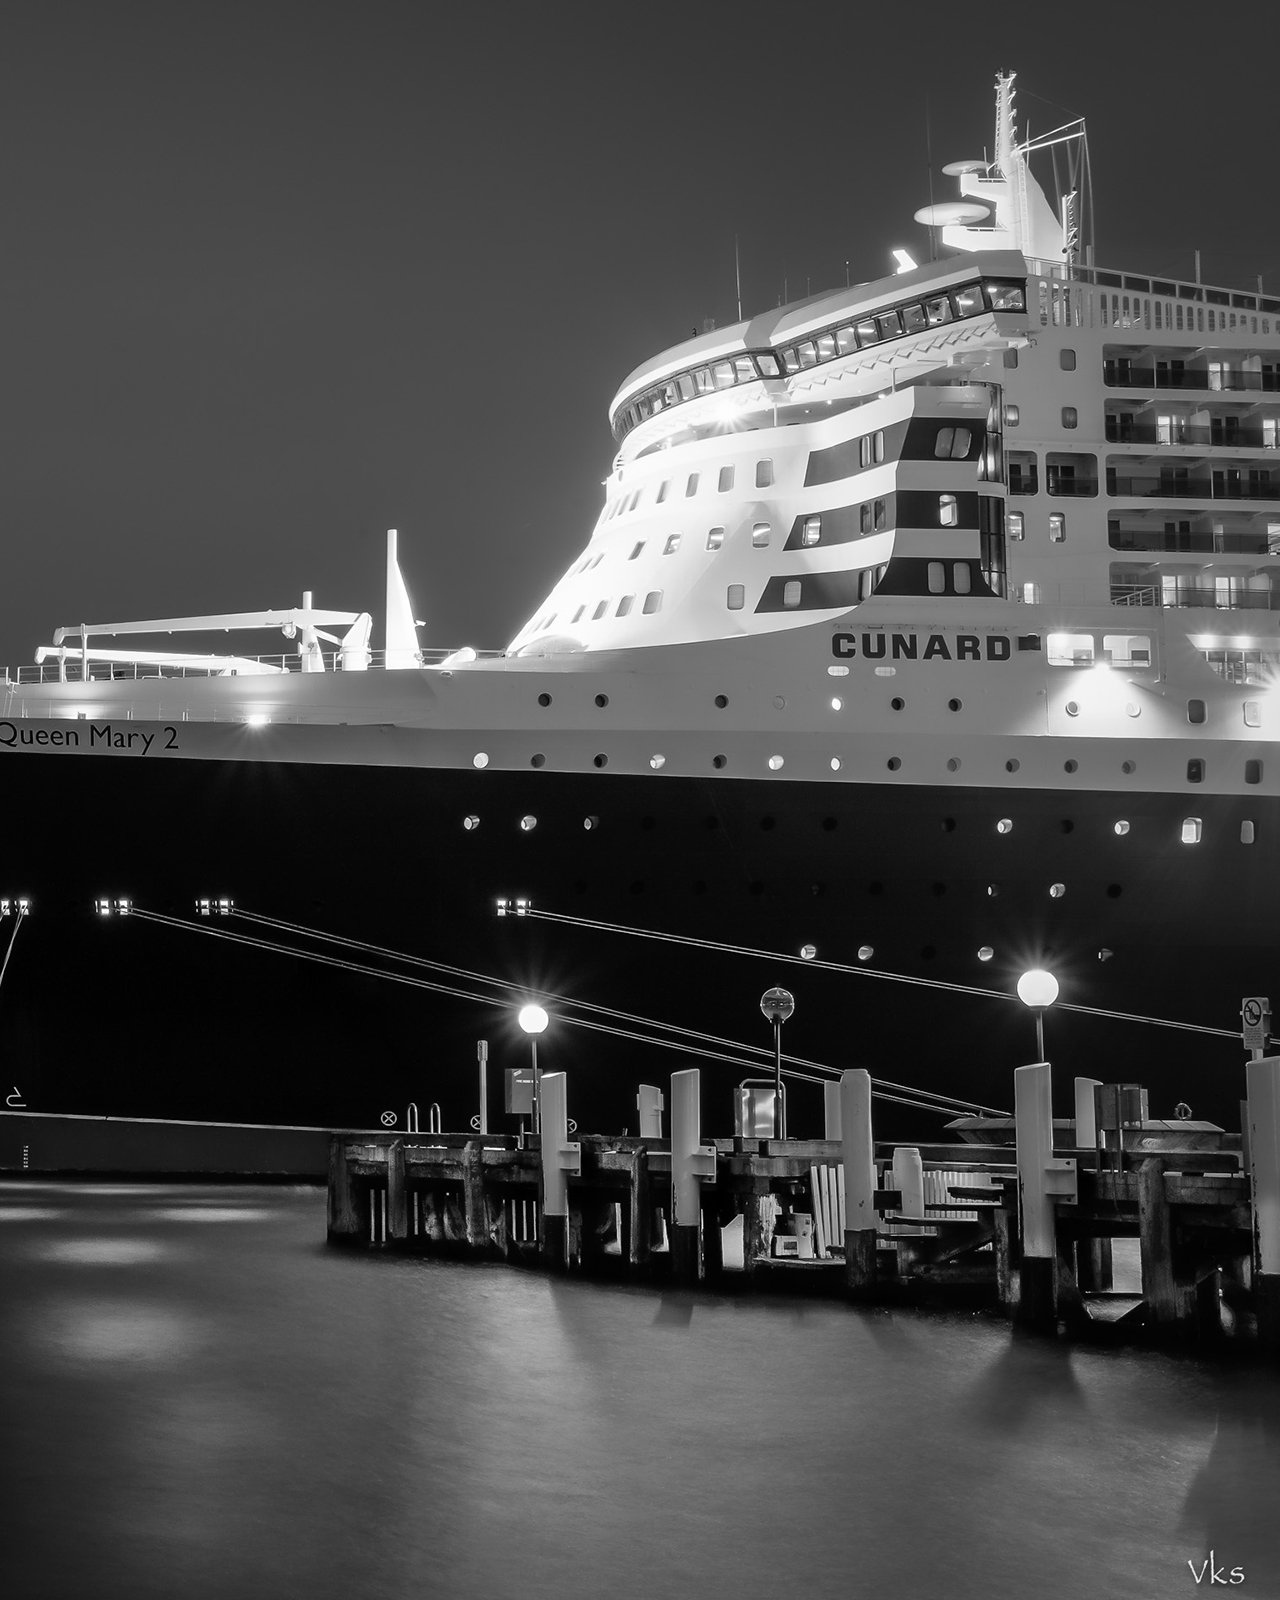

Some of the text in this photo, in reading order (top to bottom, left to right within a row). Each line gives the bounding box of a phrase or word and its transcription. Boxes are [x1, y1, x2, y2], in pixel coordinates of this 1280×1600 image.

[831, 632, 1011, 661] CUNARD
[89, 724, 155, 756] Mary
[163, 726, 180, 750] 2
